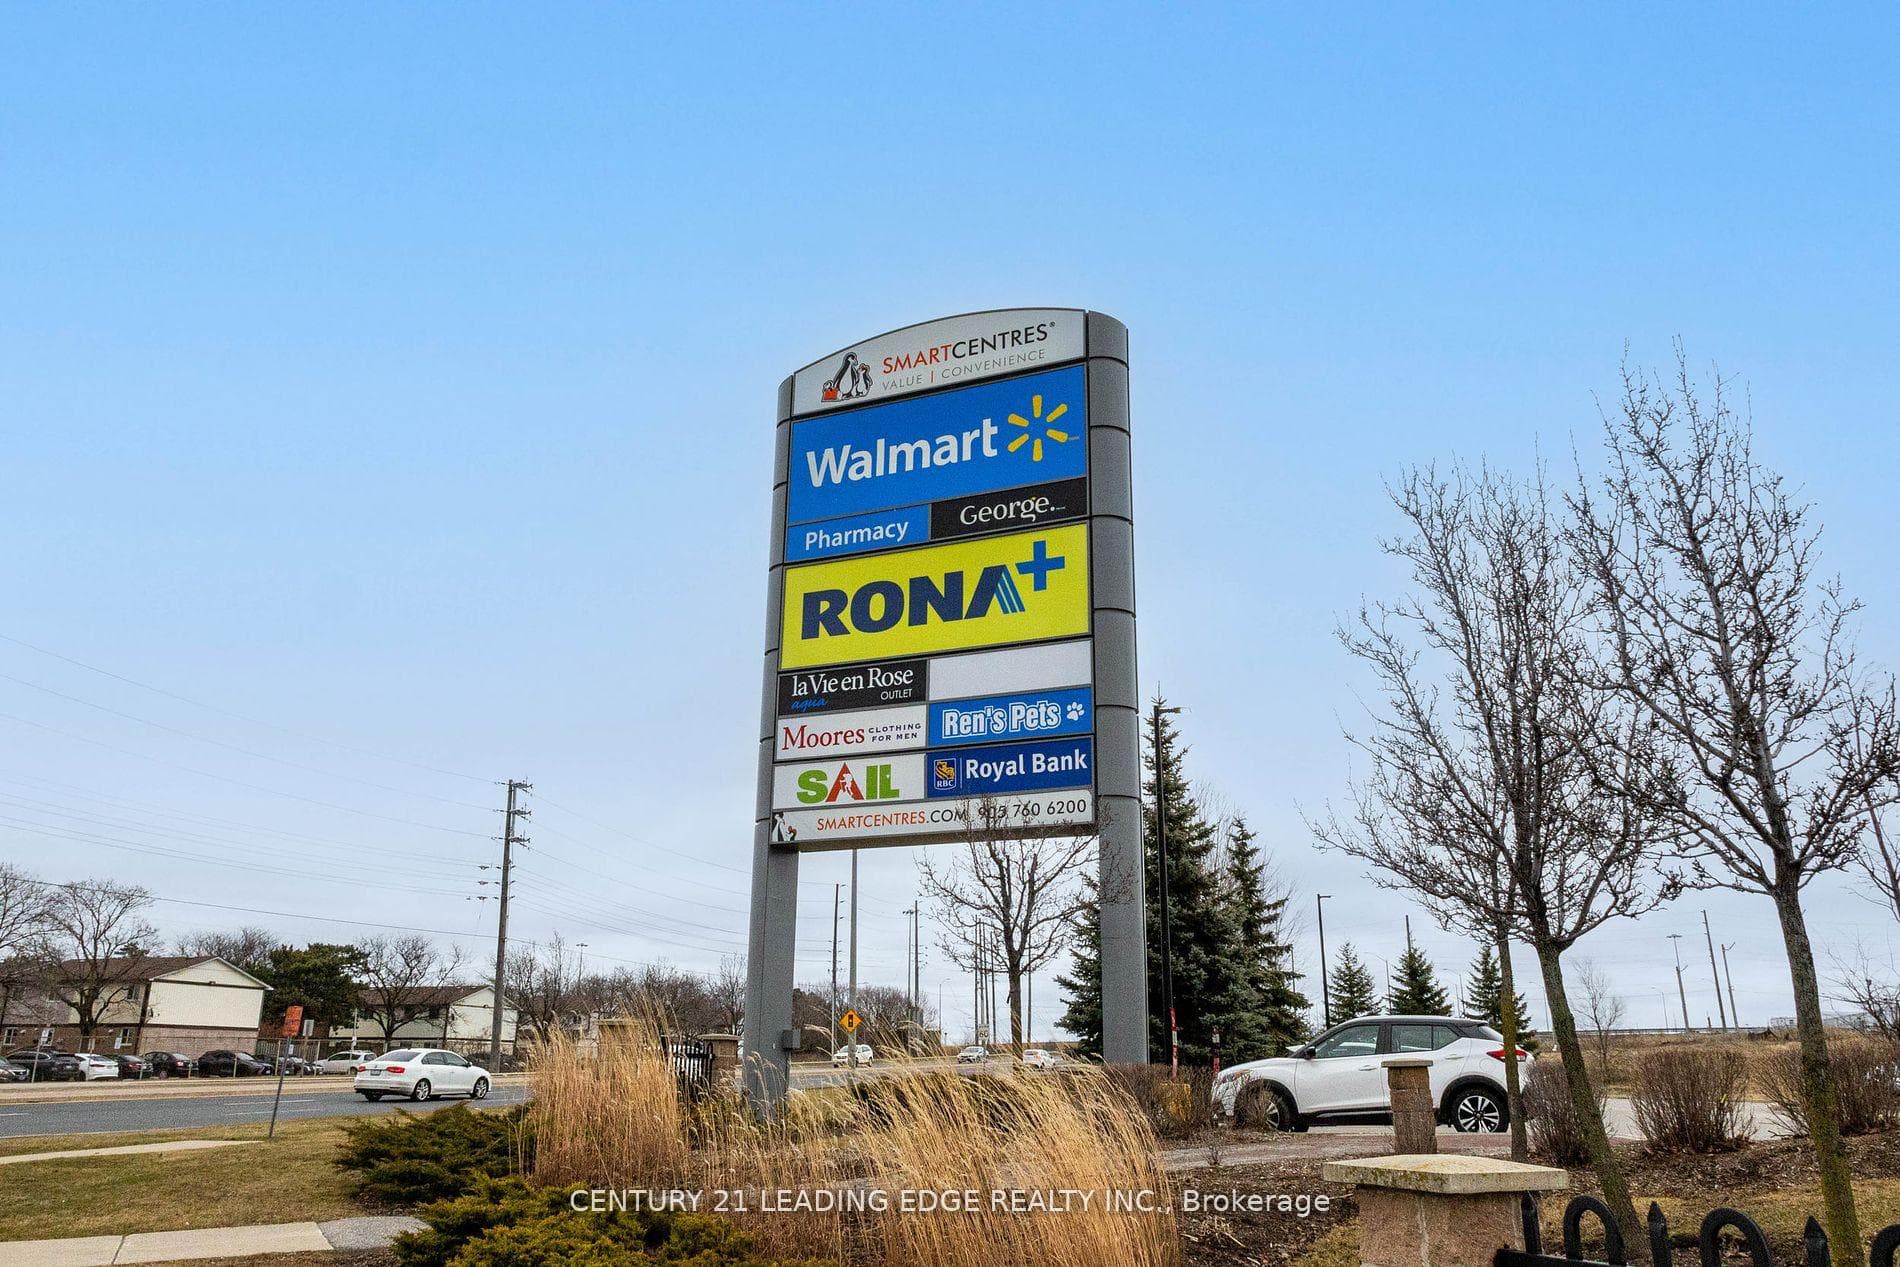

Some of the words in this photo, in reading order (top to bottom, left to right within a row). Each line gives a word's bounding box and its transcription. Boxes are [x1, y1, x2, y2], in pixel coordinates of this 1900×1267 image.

[881, 375, 923, 391] VALUE
[941, 349, 1046, 380] CONVENIENCE
[806, 418, 998, 488] Walmart
[805, 521, 909, 550] Pharmacy
[841, 676, 865, 691] en
[867, 667, 914, 689] Rose
[791, 698, 828, 712] aqua
[880, 688, 913, 700] OUTLET
[868, 723, 922, 734] CLOTHING
[942, 705, 1007, 739] Ren's
[1009, 700, 1061, 732] Pets
[781, 724, 865, 750] Moores
[871, 735, 892, 743] FOR
[896, 732, 918, 741] MEN
[965, 753, 1026, 782] Royal
[1031, 748, 1088, 774] Bank
[796, 762, 900, 804] SAIL
[936, 779, 954, 788] RBC
[1013, 801, 1041, 818] 760
[1046, 799, 1087, 815] 6200
